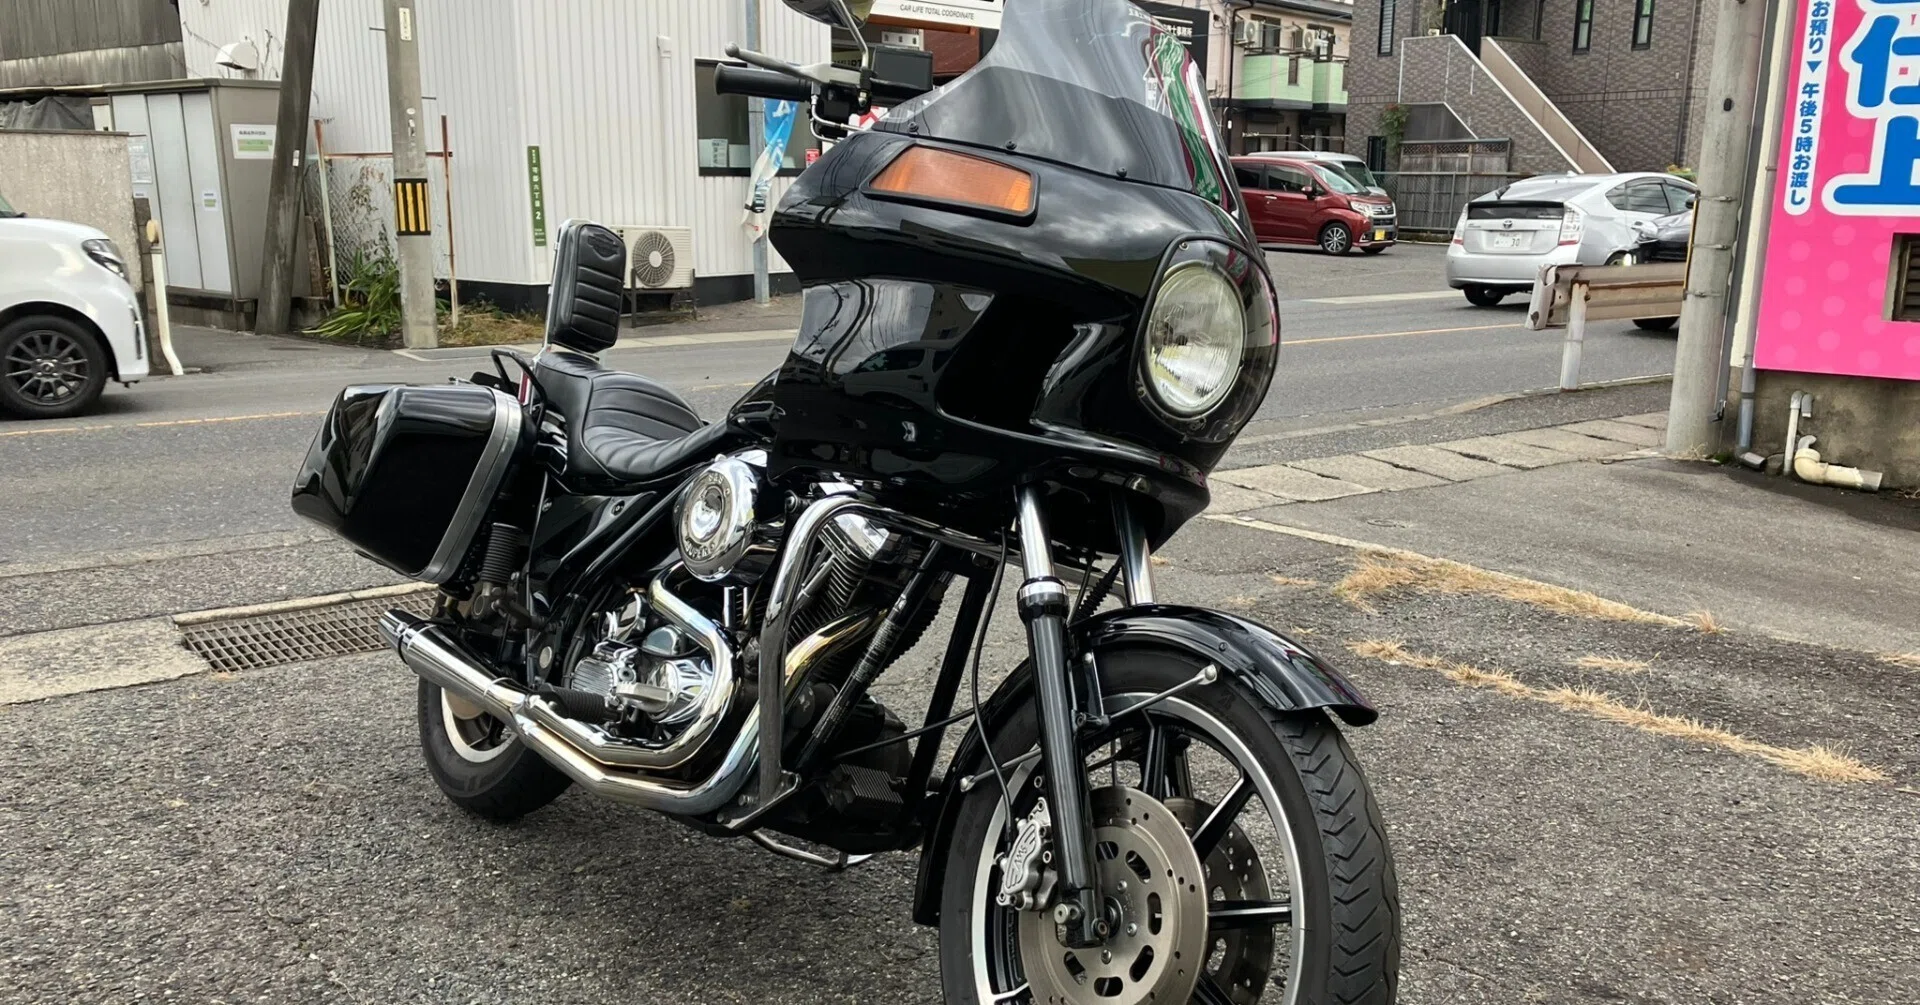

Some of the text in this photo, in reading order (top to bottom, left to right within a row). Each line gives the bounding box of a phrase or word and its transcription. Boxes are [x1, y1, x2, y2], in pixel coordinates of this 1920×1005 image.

[900, 4, 975, 20] CAR LIFE TOTAL COORDINATE
[1790, 0, 1830, 206] お預り 午後5時お渡し
[1833, 0, 1920, 206] 仕上
[535, 211, 541, 220] 2
